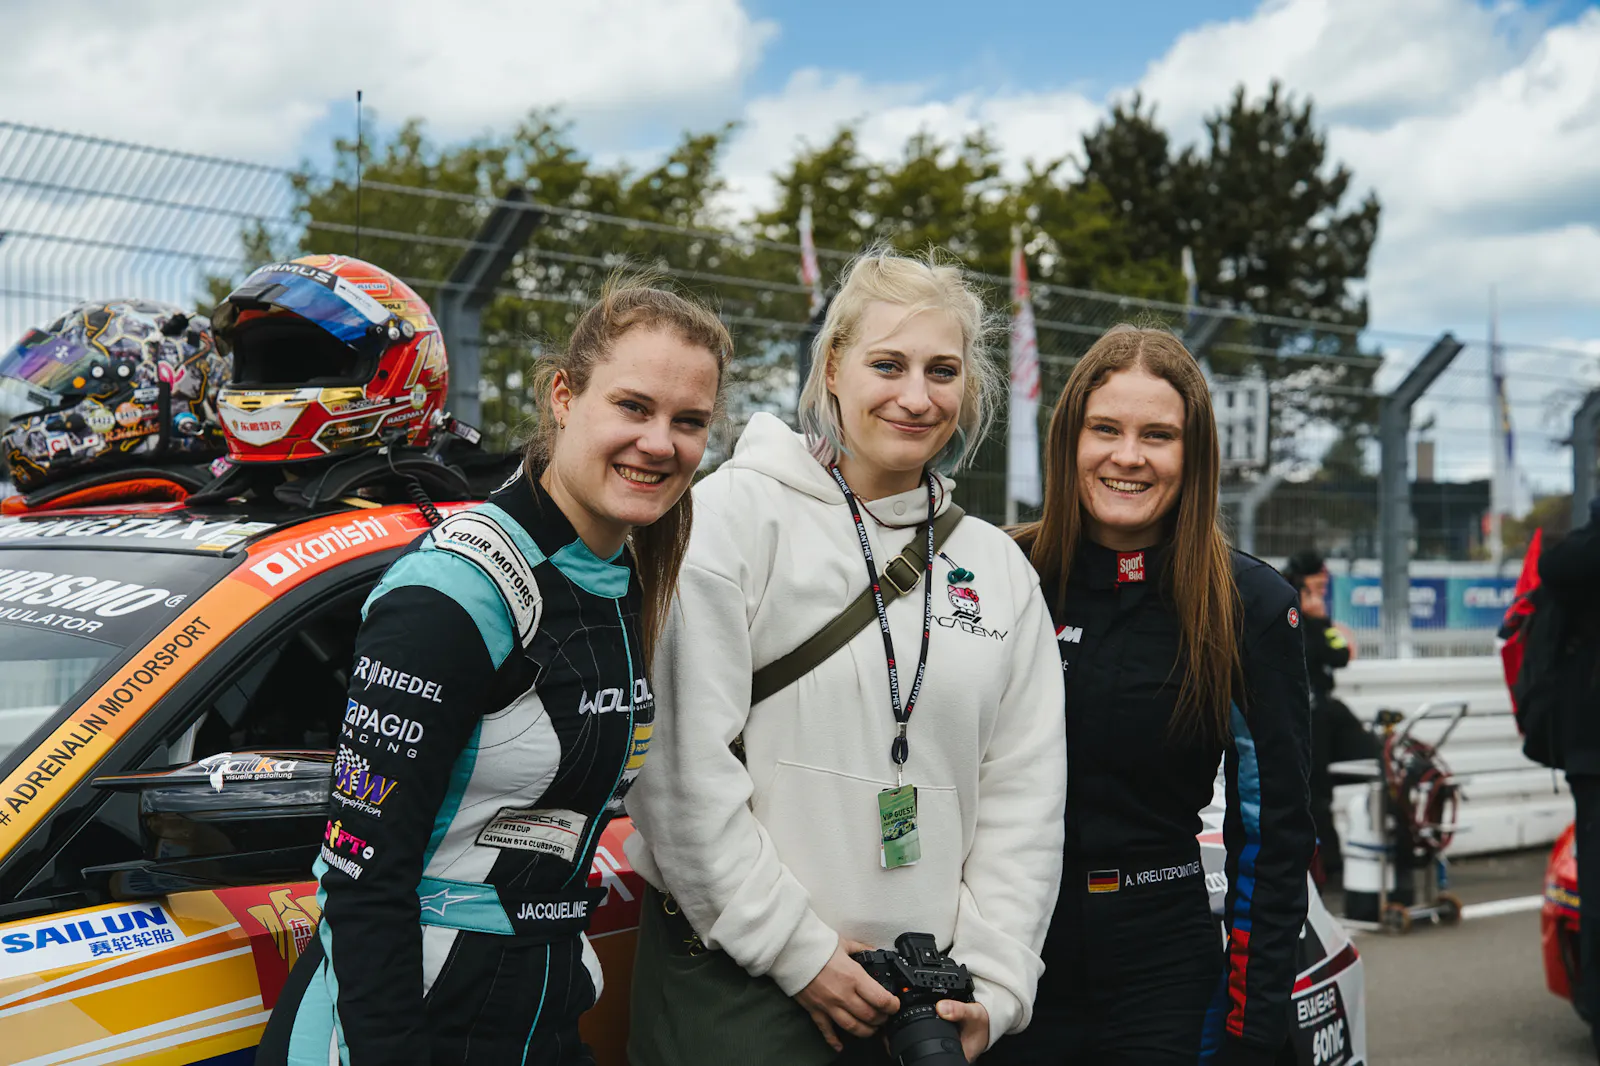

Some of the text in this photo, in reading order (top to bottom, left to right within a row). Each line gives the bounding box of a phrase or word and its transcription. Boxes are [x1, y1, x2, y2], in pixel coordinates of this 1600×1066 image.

[832, 467, 852, 495] MANTHEY
[286, 515, 389, 568] Konishi
[857, 522, 873, 561] MANTHEY
[449, 531, 535, 607] FOUR MOTORS
[1119, 554, 1144, 574] Sport
[1128, 570, 1143, 581] Bild
[875, 593, 890, 634] MANTHEY
[377, 666, 443, 703] RIEDEL
[889, 668, 901, 710] MANTHEY
[910, 662, 925, 704] MANTHEY
[5, 713, 109, 814] ADRENALIN
[98, 615, 211, 717] MOTORSPORT
[355, 704, 424, 743] PAGID
[254, 771, 293, 780] gestaltung
[336, 761, 398, 805] KW
[331, 790, 381, 817] competition
[883, 812, 893, 821] VIP
[895, 806, 914, 817] GUEST
[484, 834, 513, 845] CAYMAN
[528, 840, 564, 855] CLUBSPORT
[516, 825, 531, 834] CUP
[1125, 874, 1135, 887] A.
[517, 900, 588, 920] JACQUELINE
[1, 906, 168, 954] SAILUN
[88, 928, 175, 957] 赛轮轮胎
[1297, 987, 1337, 1021] BWEAR
